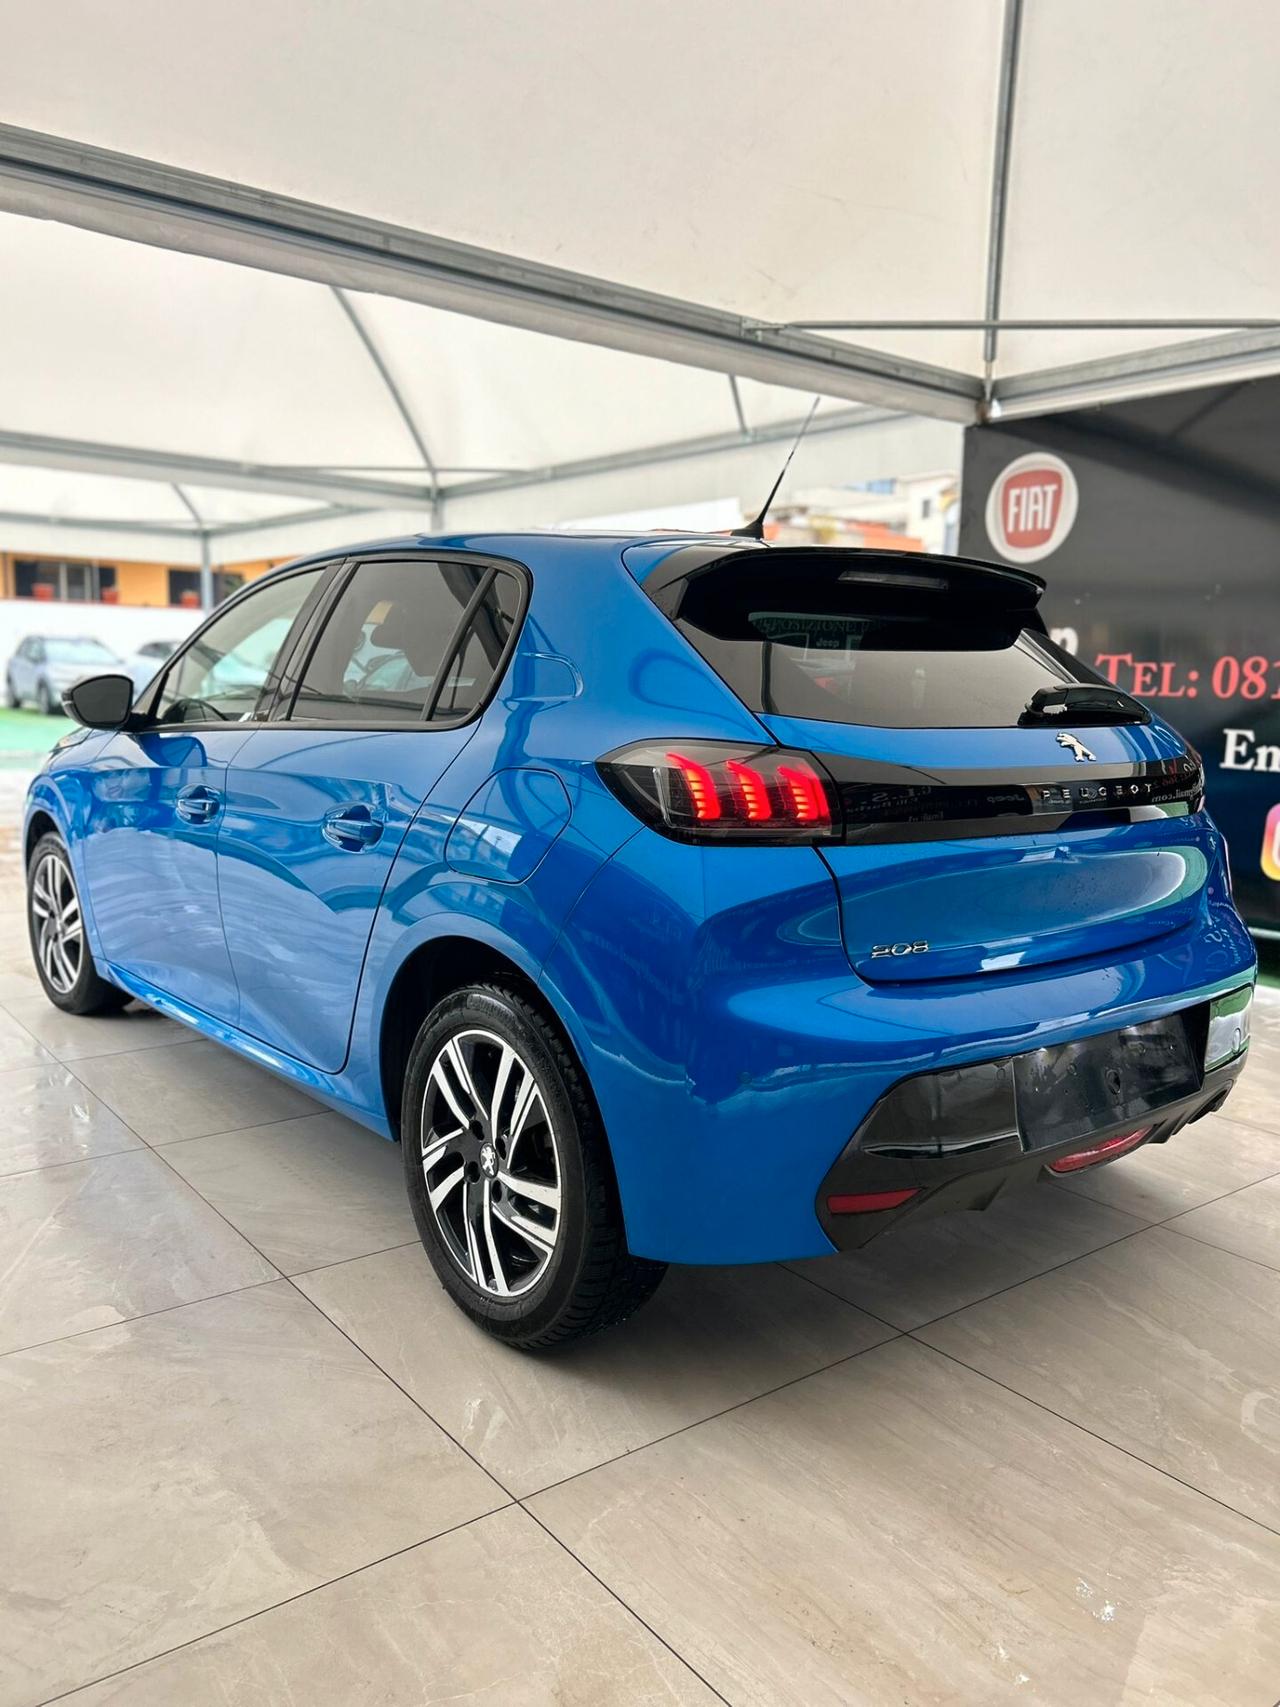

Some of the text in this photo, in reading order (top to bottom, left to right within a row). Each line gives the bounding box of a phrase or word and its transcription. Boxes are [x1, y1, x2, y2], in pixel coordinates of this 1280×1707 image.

[1007, 482, 1058, 535] FIAT
[1095, 653, 1199, 698] TEL:
[1042, 783, 1152, 799] PEUGEOT
[871, 940, 929, 959] 208
